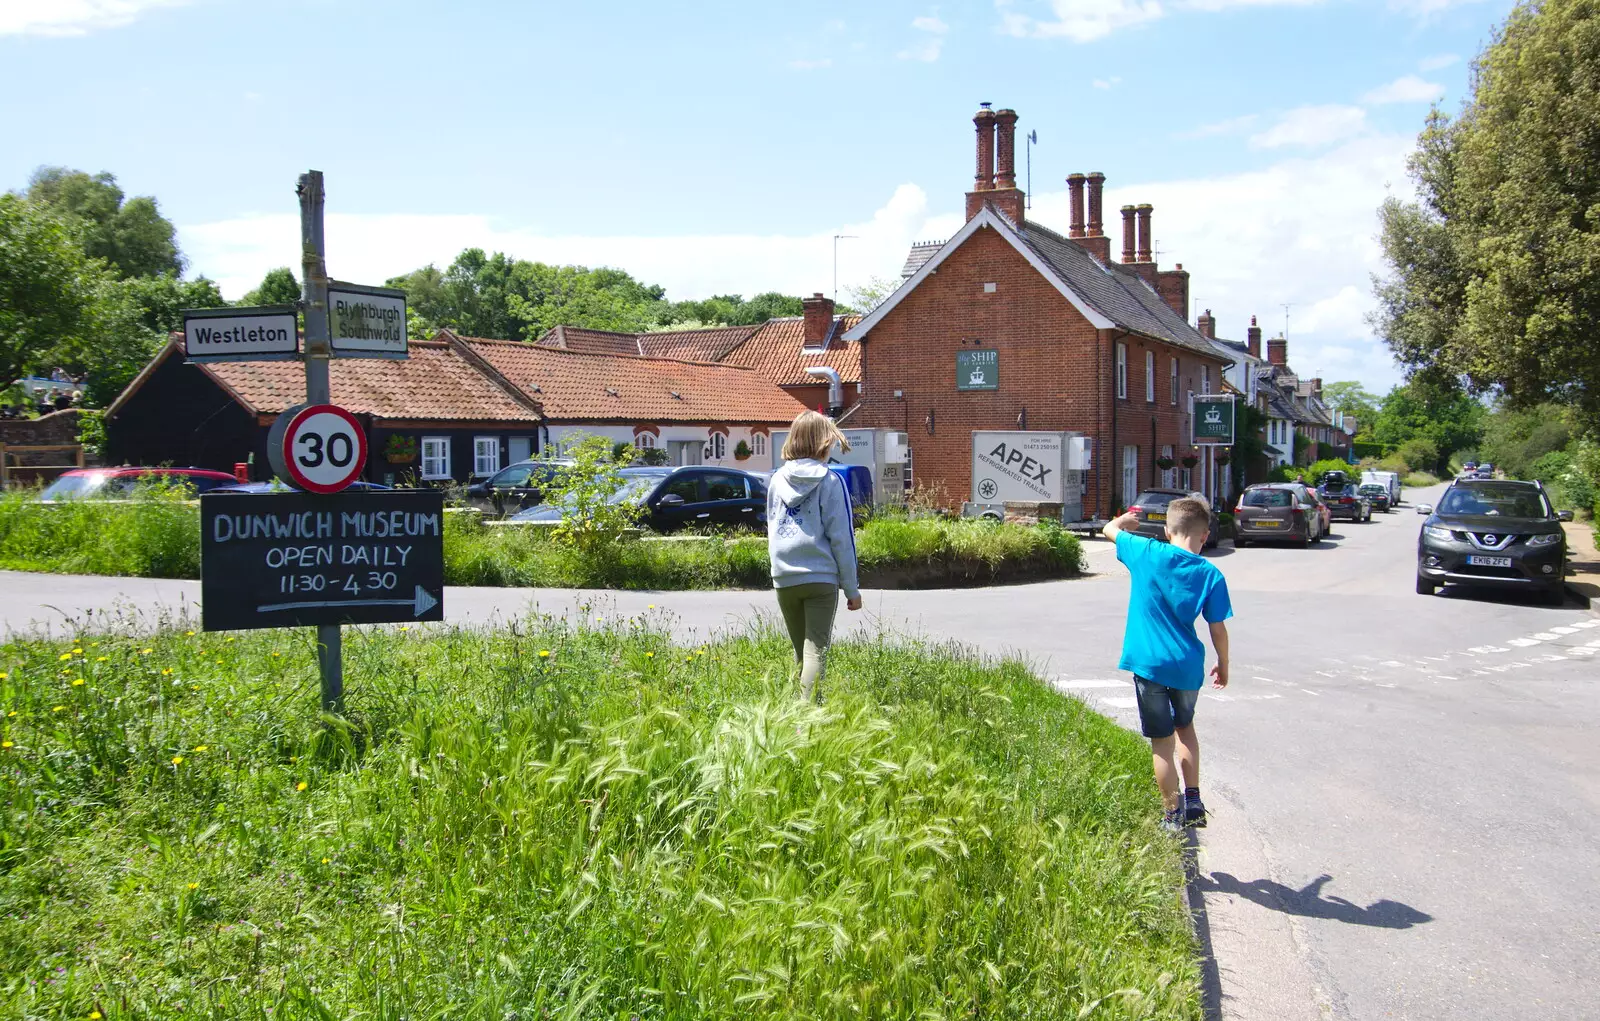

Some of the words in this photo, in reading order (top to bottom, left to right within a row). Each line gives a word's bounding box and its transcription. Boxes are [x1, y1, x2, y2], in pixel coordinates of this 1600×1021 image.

[336, 300, 400, 323] Blythburgh
[194, 325, 287, 344] Westleton
[339, 322, 401, 341] Southwold
[971, 351, 996, 362] SHIP
[298, 432, 353, 467] 30
[883, 467, 898, 477] APEX
[989, 442, 1052, 486] APEX
[977, 453, 1022, 482] REFRIGERATED
[1022, 479, 1052, 499] TRAILERS
[214, 511, 332, 543] DUNWICH
[341, 510, 440, 538] MUSEUM
[265, 545, 333, 569] OPEN
[341, 544, 412, 567] DAILY
[1473, 556, 1491, 565] EK16
[1492, 557, 1509, 566] ZFC
